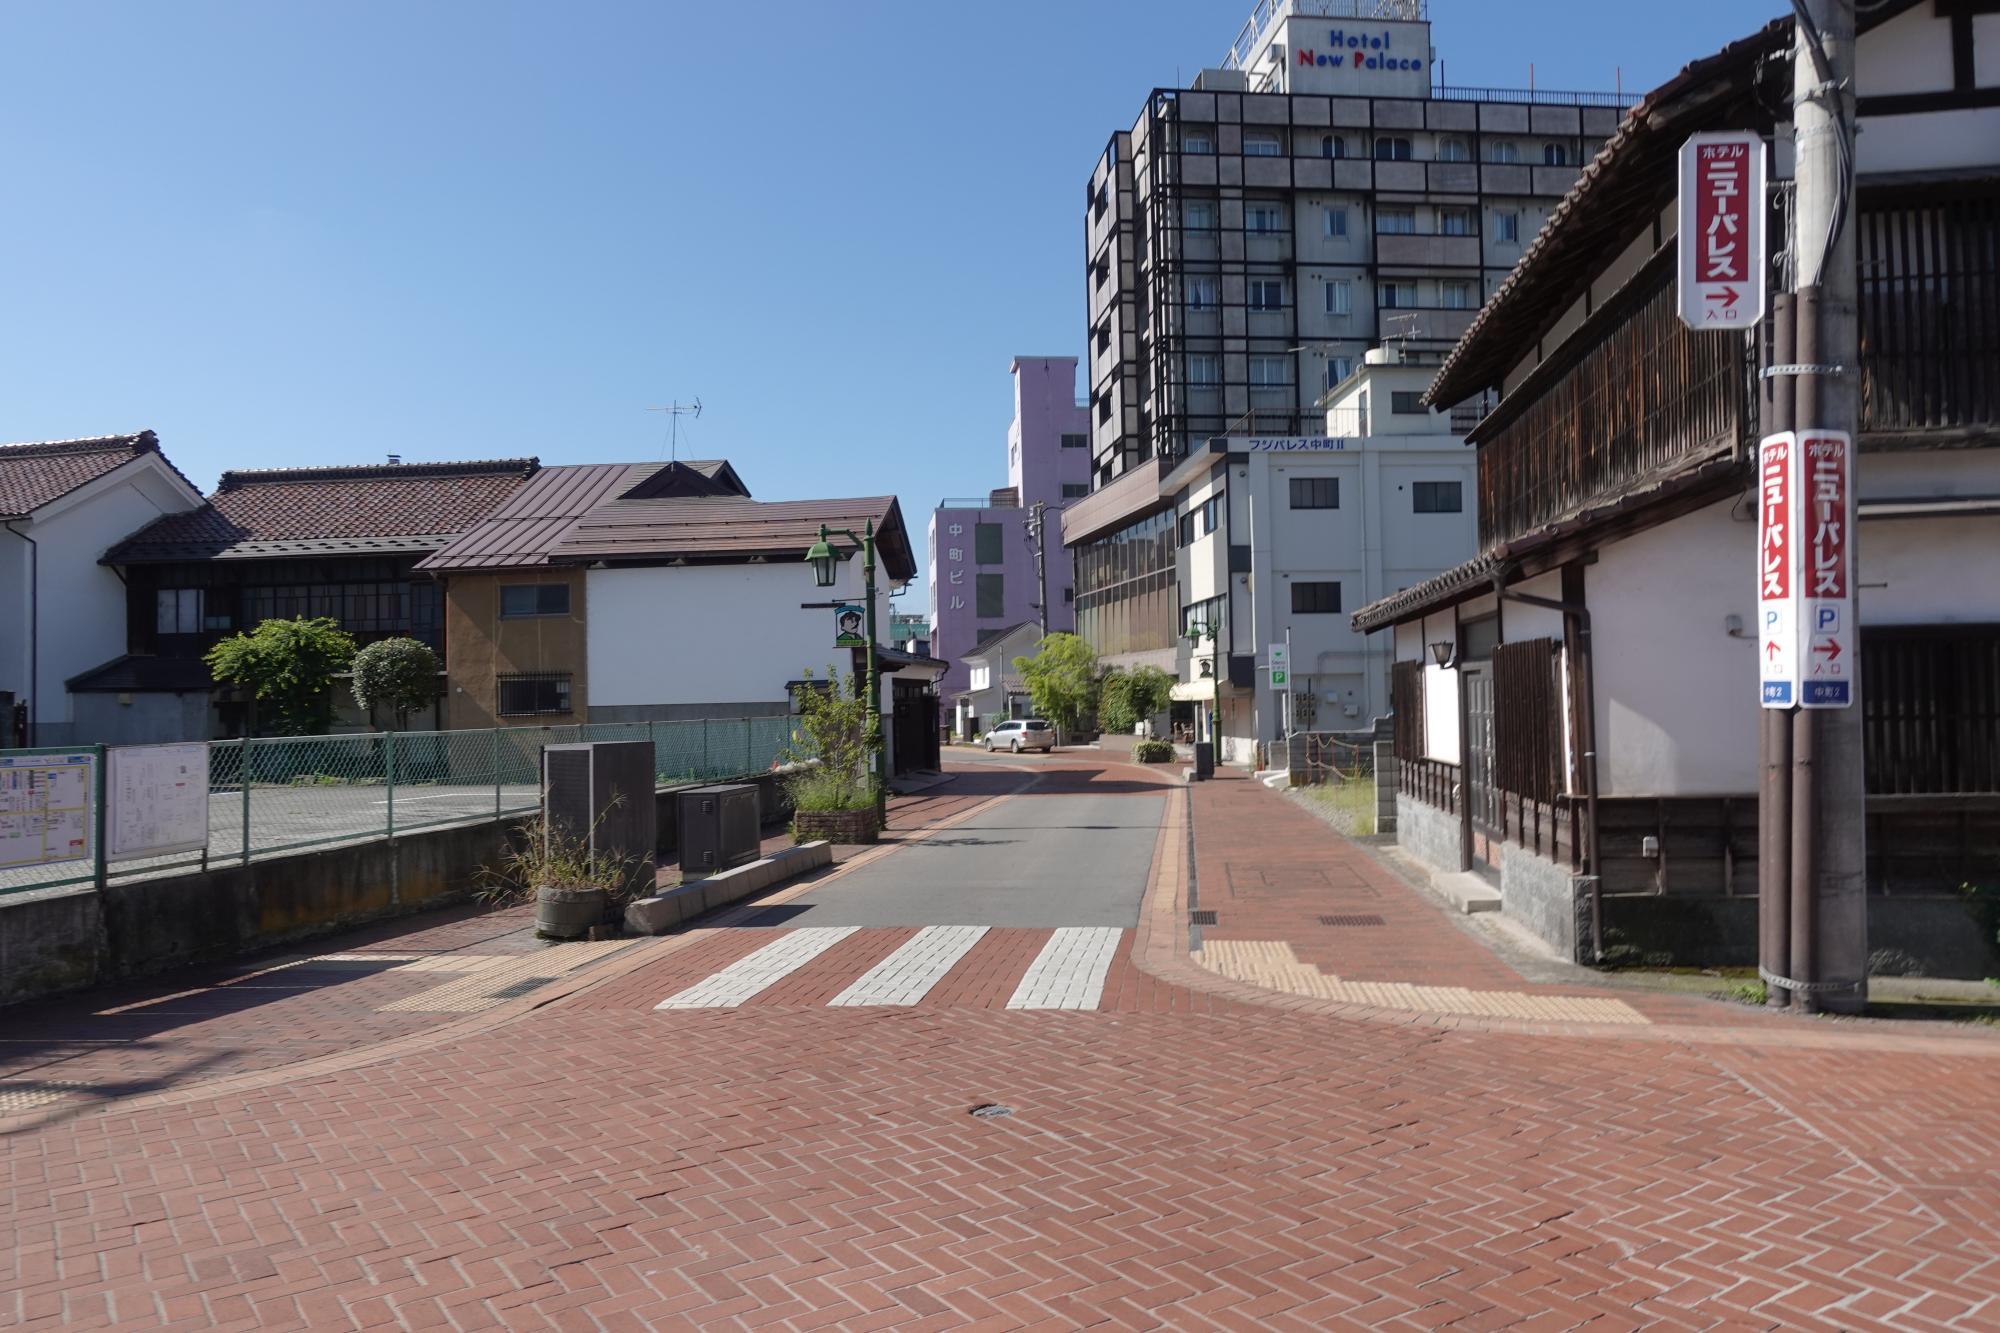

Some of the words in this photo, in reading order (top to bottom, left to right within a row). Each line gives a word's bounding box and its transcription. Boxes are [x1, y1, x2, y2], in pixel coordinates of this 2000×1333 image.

[1330, 30, 1390, 49] Hotel
[1298, 48, 1343, 67] New
[1354, 51, 1422, 71] Palace
[1702, 146, 1744, 159] ホテル
[1706, 161, 1739, 278] ニューパレス
[1705, 309, 1738, 321] 入口
[1763, 445, 1788, 466] ホテル
[1808, 442, 1844, 457] ホテル
[1763, 464, 1784, 597] ニューパレス
[1812, 461, 1840, 595] ニューパレス
[948, 522, 965, 610] 中町ビル
[1767, 611, 1778, 630] P
[1819, 608, 1836, 629] P
[1814, 663, 1841, 675] 入口
